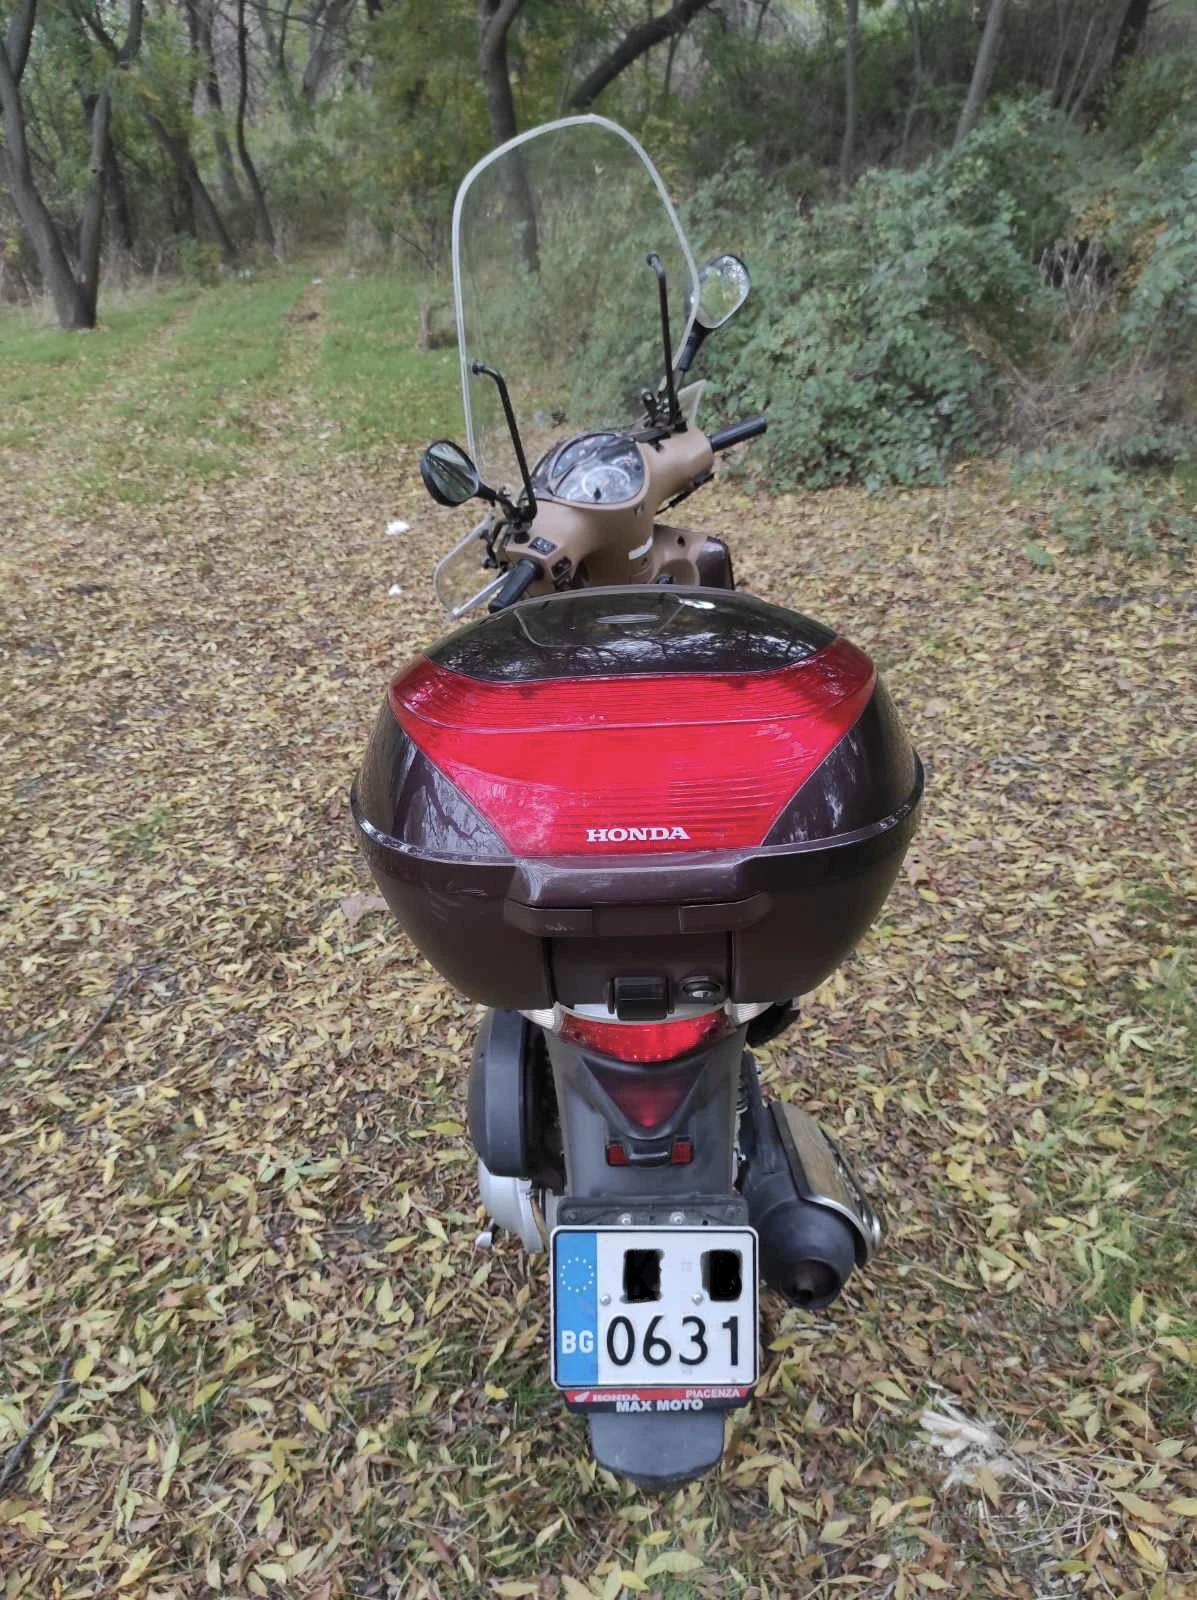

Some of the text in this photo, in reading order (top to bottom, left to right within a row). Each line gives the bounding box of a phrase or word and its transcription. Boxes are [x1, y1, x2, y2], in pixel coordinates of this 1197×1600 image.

[586, 826, 691, 842] HONDA
[561, 1330, 594, 1354] BG
[606, 1315, 739, 1367] 0631
[592, 1389, 741, 1402] HONDA PIACENZA
[616, 1399, 704, 1413] MAX MOTO
